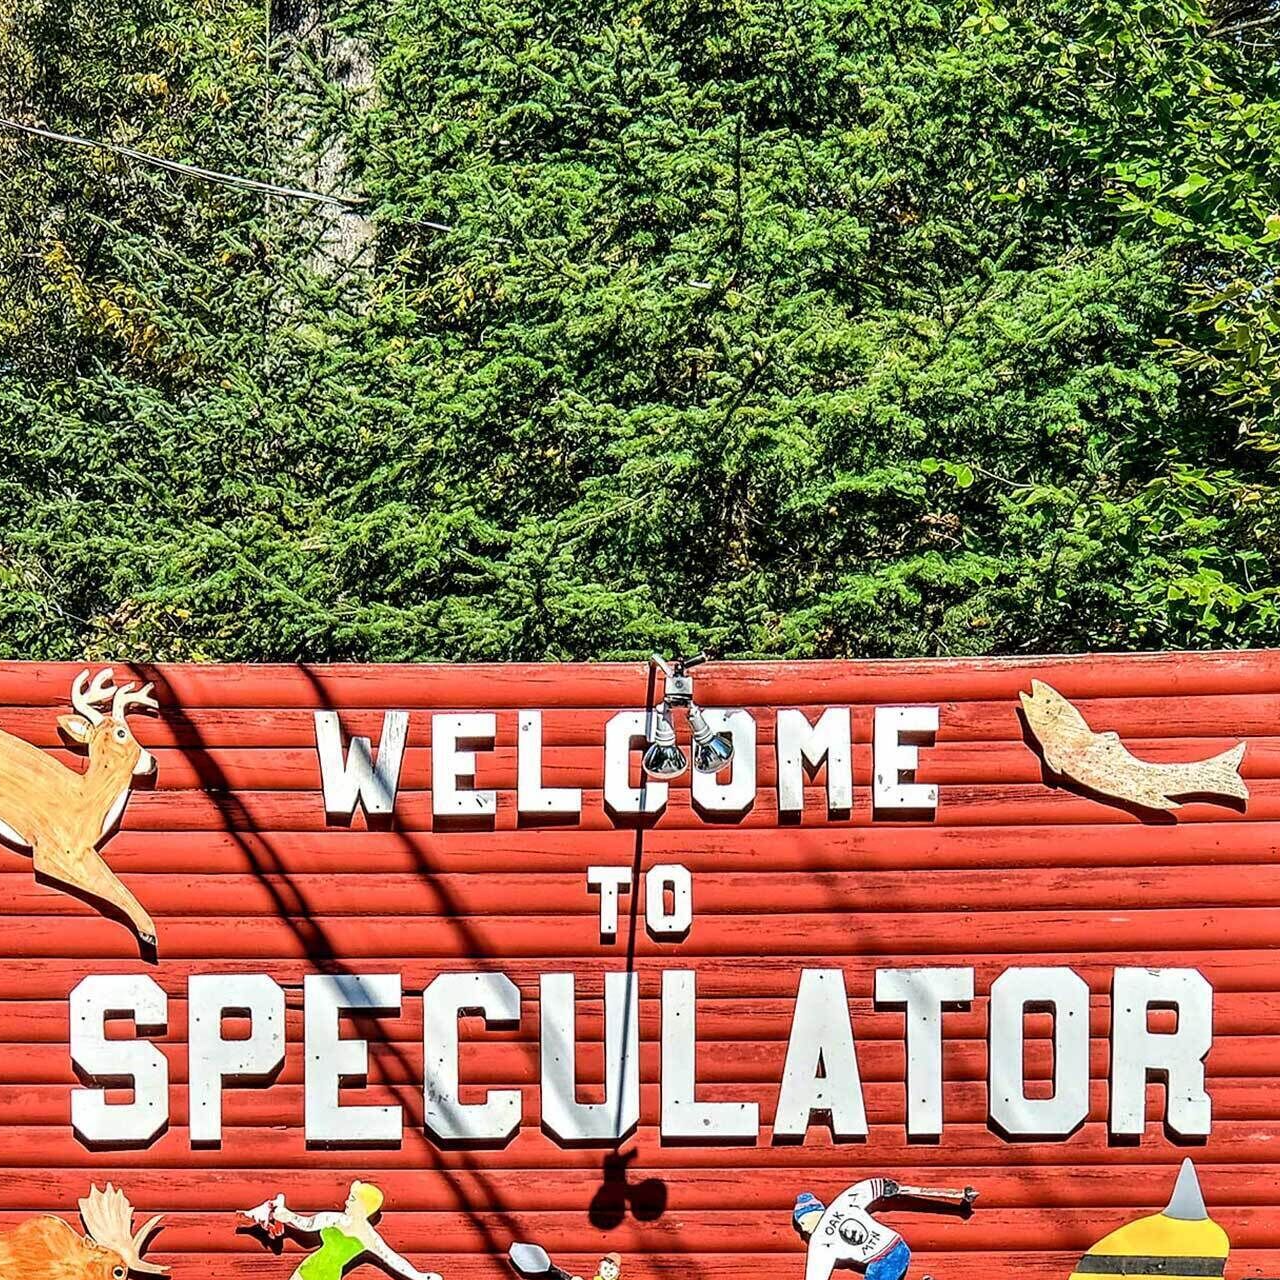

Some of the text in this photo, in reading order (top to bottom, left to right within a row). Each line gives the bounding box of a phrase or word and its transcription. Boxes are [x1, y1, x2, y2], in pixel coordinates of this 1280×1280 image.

[314, 706, 940, 815] WELCOME
[587, 864, 693, 934] TO
[69, 967, 1215, 1143] SPECULATOR
[825, 1211, 845, 1236] OAK
[861, 1230, 881, 1256] MTN
